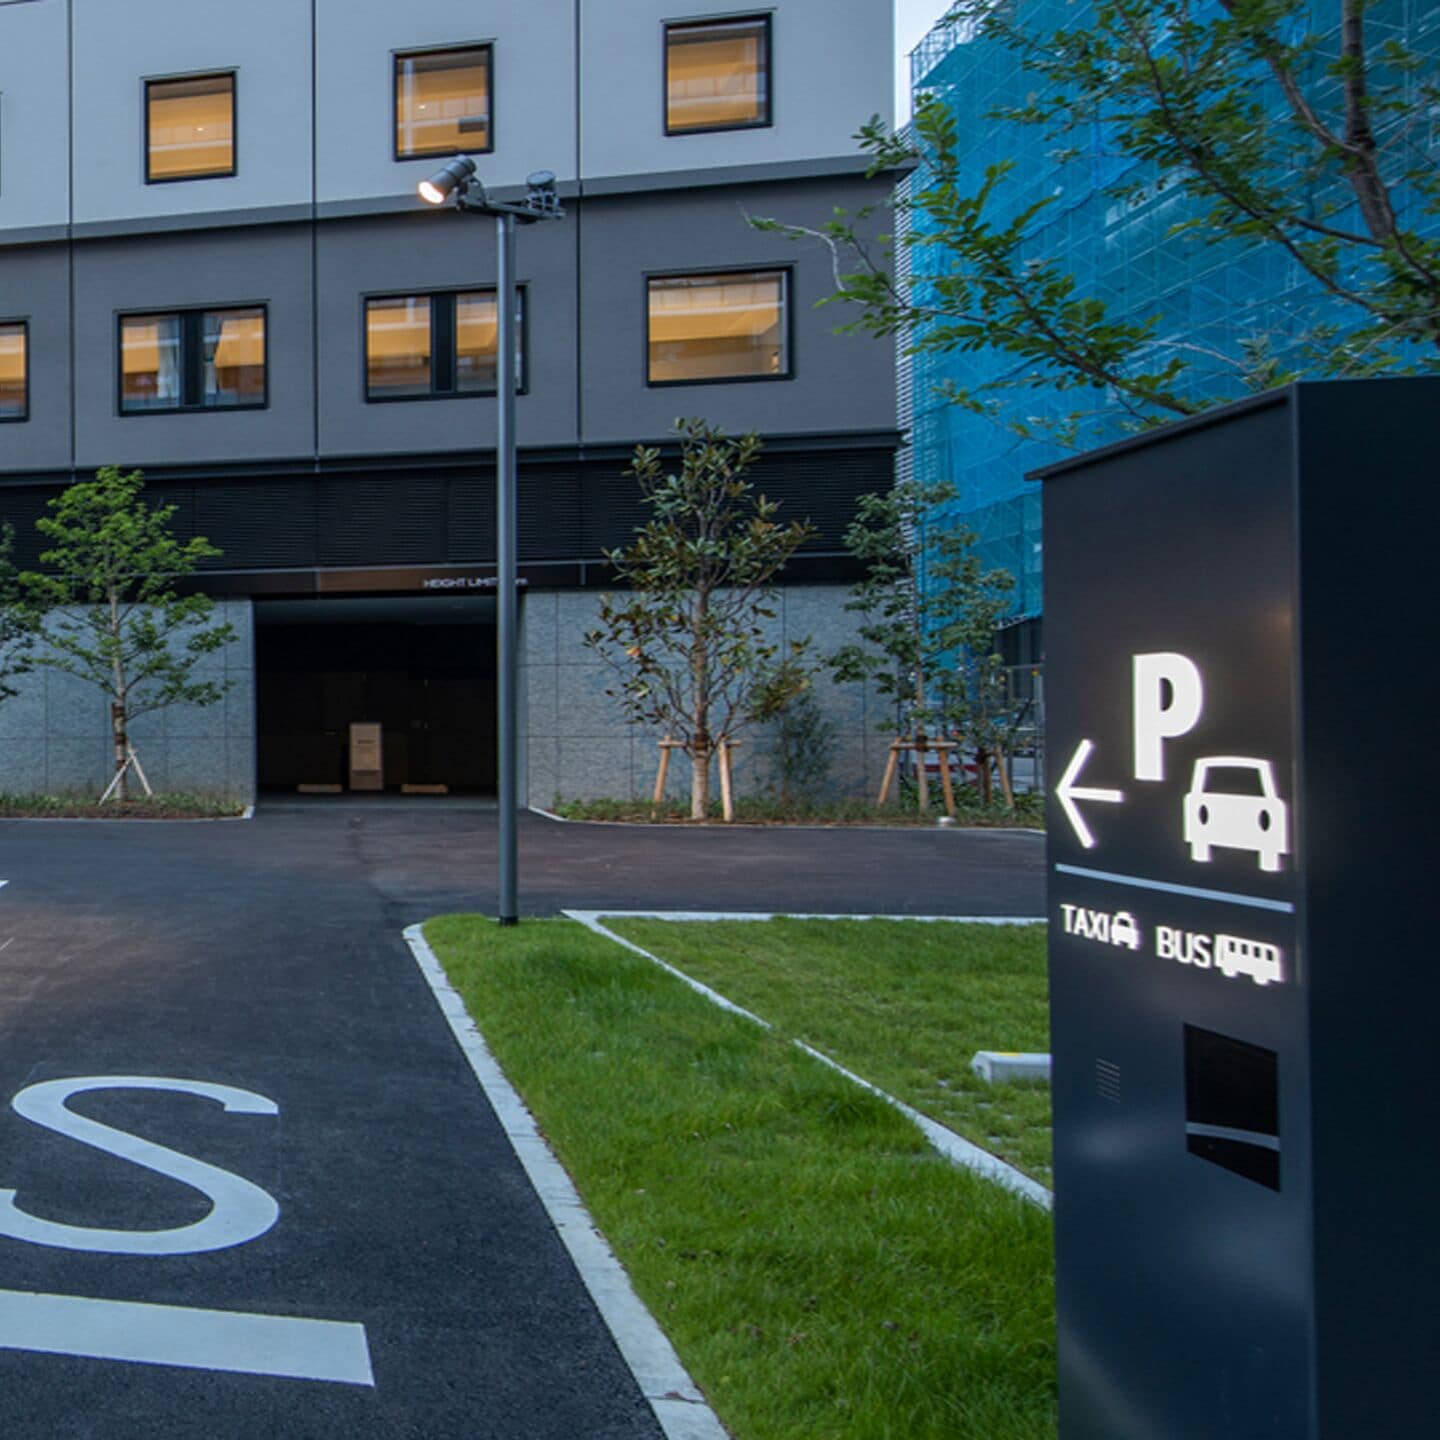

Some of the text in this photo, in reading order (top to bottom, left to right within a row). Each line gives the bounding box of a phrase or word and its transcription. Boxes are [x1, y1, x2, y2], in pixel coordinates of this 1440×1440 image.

[423, 578, 466, 589] HEIGHT
[1132, 652, 1203, 781] P
[1060, 904, 1212, 969] TAXI BUS
